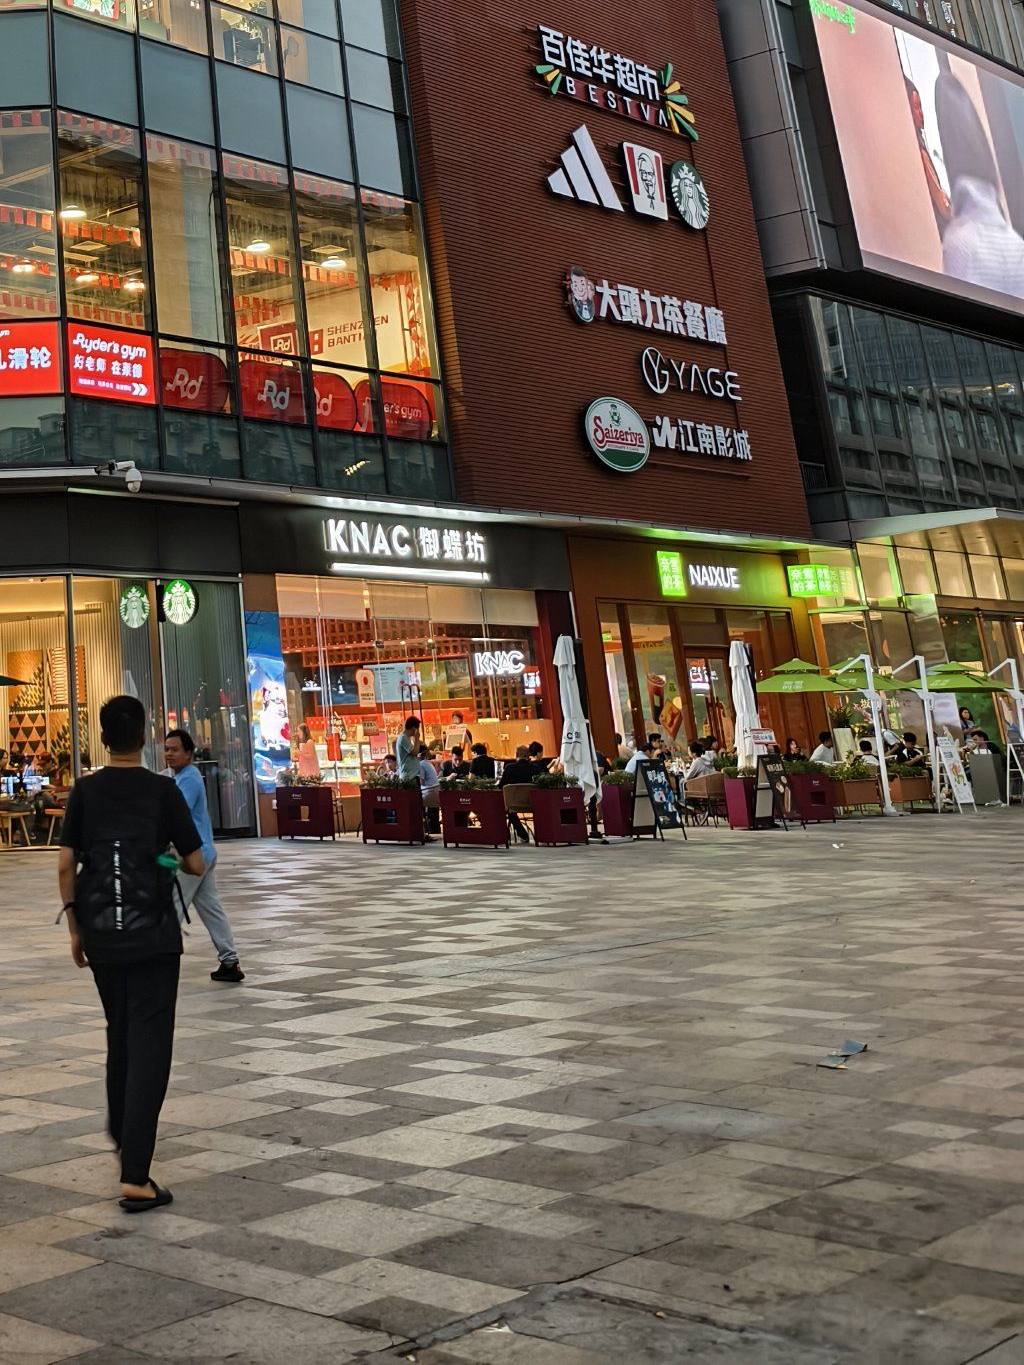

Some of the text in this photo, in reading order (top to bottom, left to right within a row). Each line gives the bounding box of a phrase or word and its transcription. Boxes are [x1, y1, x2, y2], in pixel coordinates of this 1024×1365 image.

[539, 25, 660, 101] 百佳华超市
[566, 76, 668, 127] BESTVA
[327, 315, 389, 336] SHENZEN
[73, 332, 147, 360] Ryder's gym
[401, 405, 422, 420] gym
[592, 416, 645, 450] Saizeriya
[677, 418, 753, 461] 江南影城
[326, 518, 412, 556] KNAC
[688, 564, 741, 589] NAIXUE
[475, 650, 526, 675] KNAC
